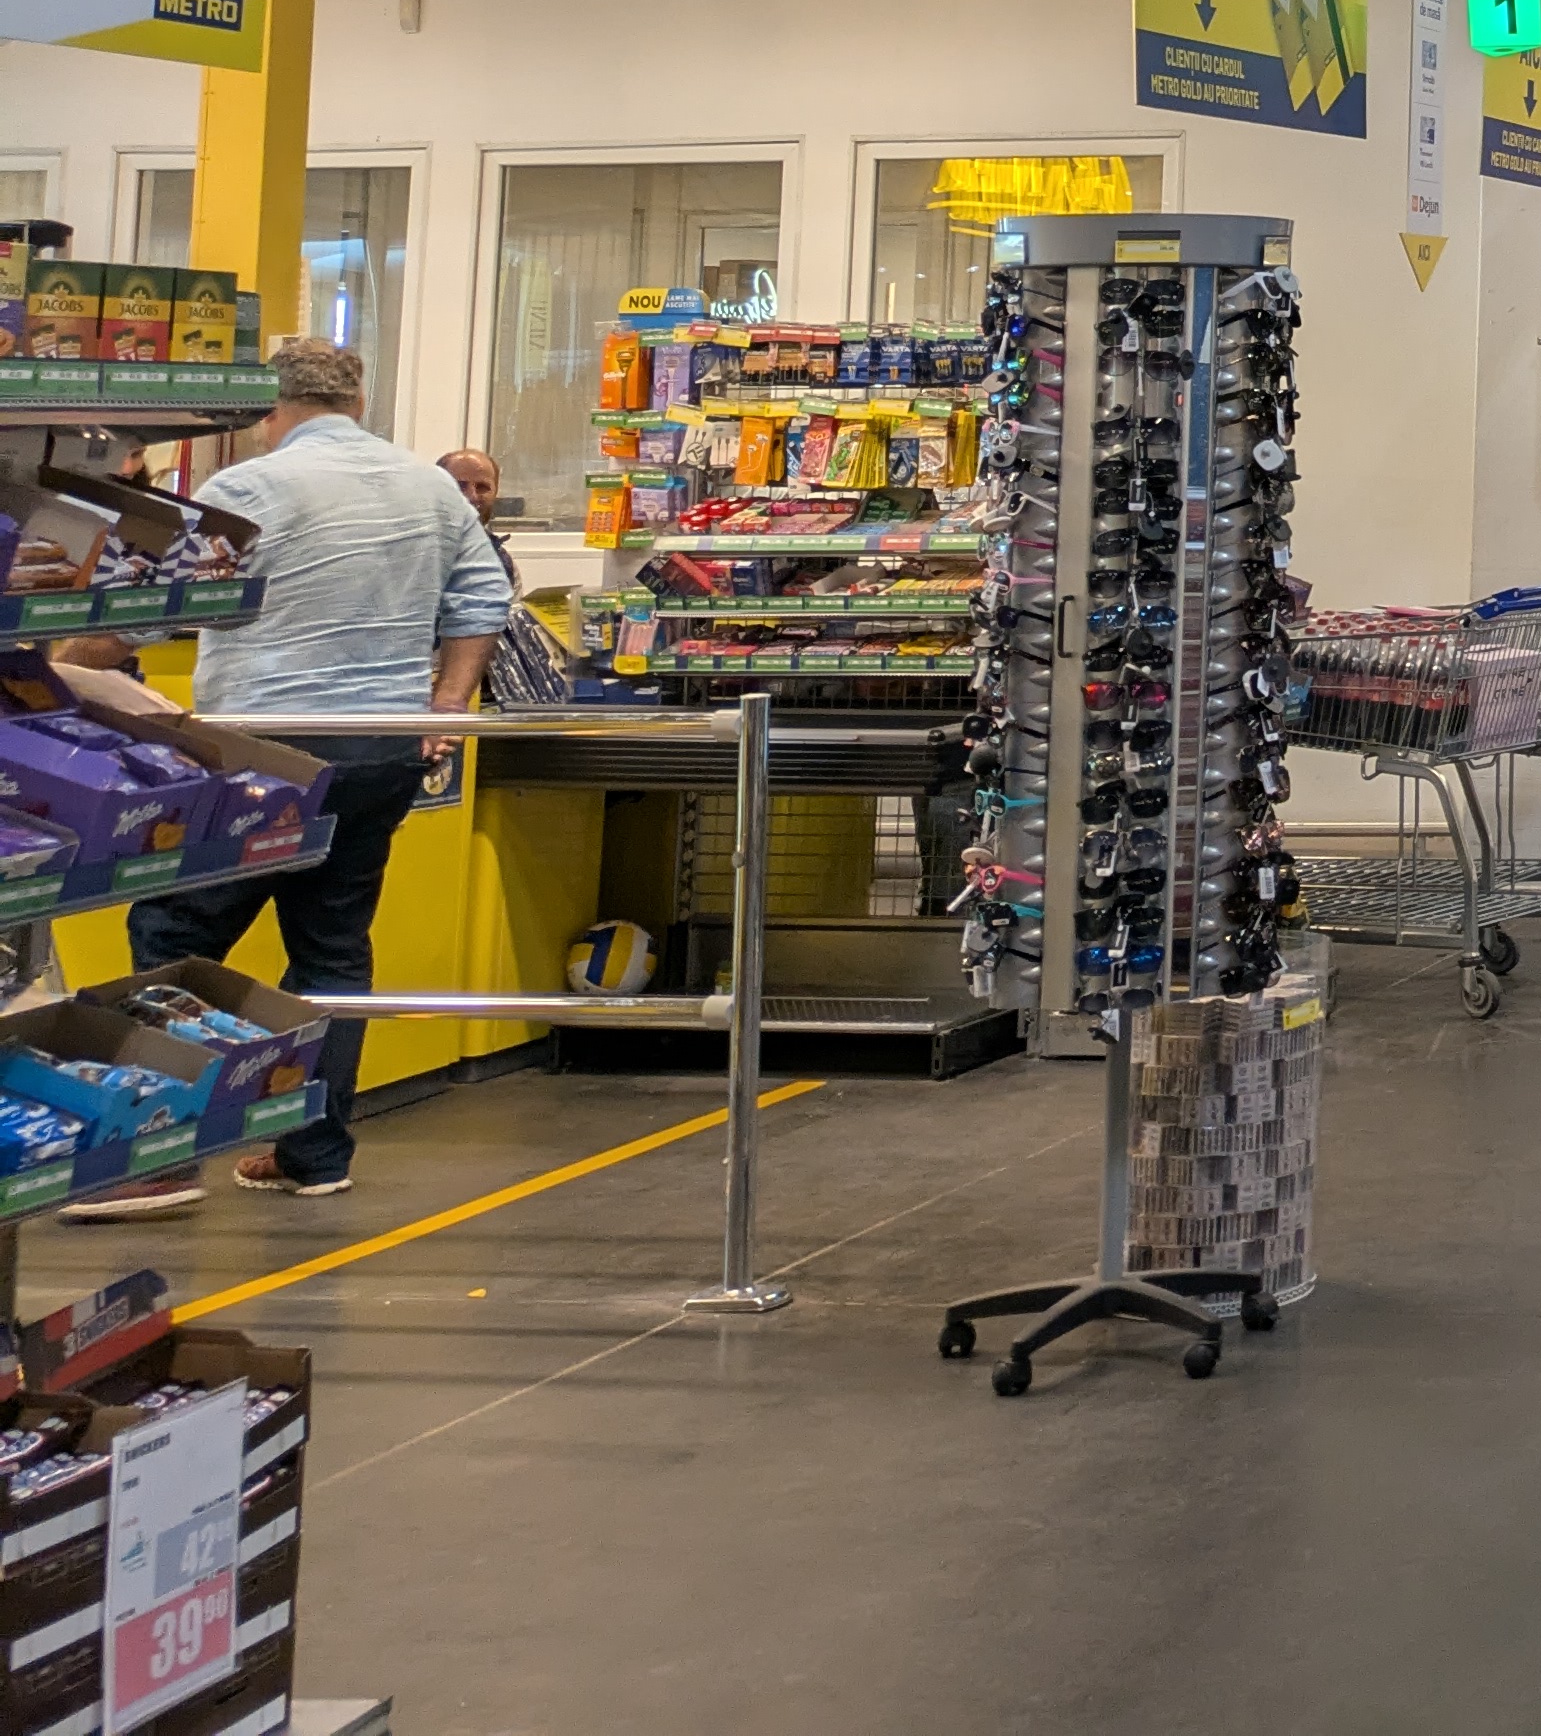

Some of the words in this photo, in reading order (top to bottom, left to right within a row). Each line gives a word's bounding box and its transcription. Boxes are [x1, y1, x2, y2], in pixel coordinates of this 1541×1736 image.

[1151, 75, 1179, 96] METRO
[1180, 81, 1202, 100] GOLD
[1202, 84, 1214, 101] AU
[1215, 86, 1260, 110] PRIORITATE
[36, 298, 84, 313] JACOBS
[628, 295, 661, 309] NOU
[120, 303, 159, 317] JACOBS
[189, 305, 225, 320] JACOBS
